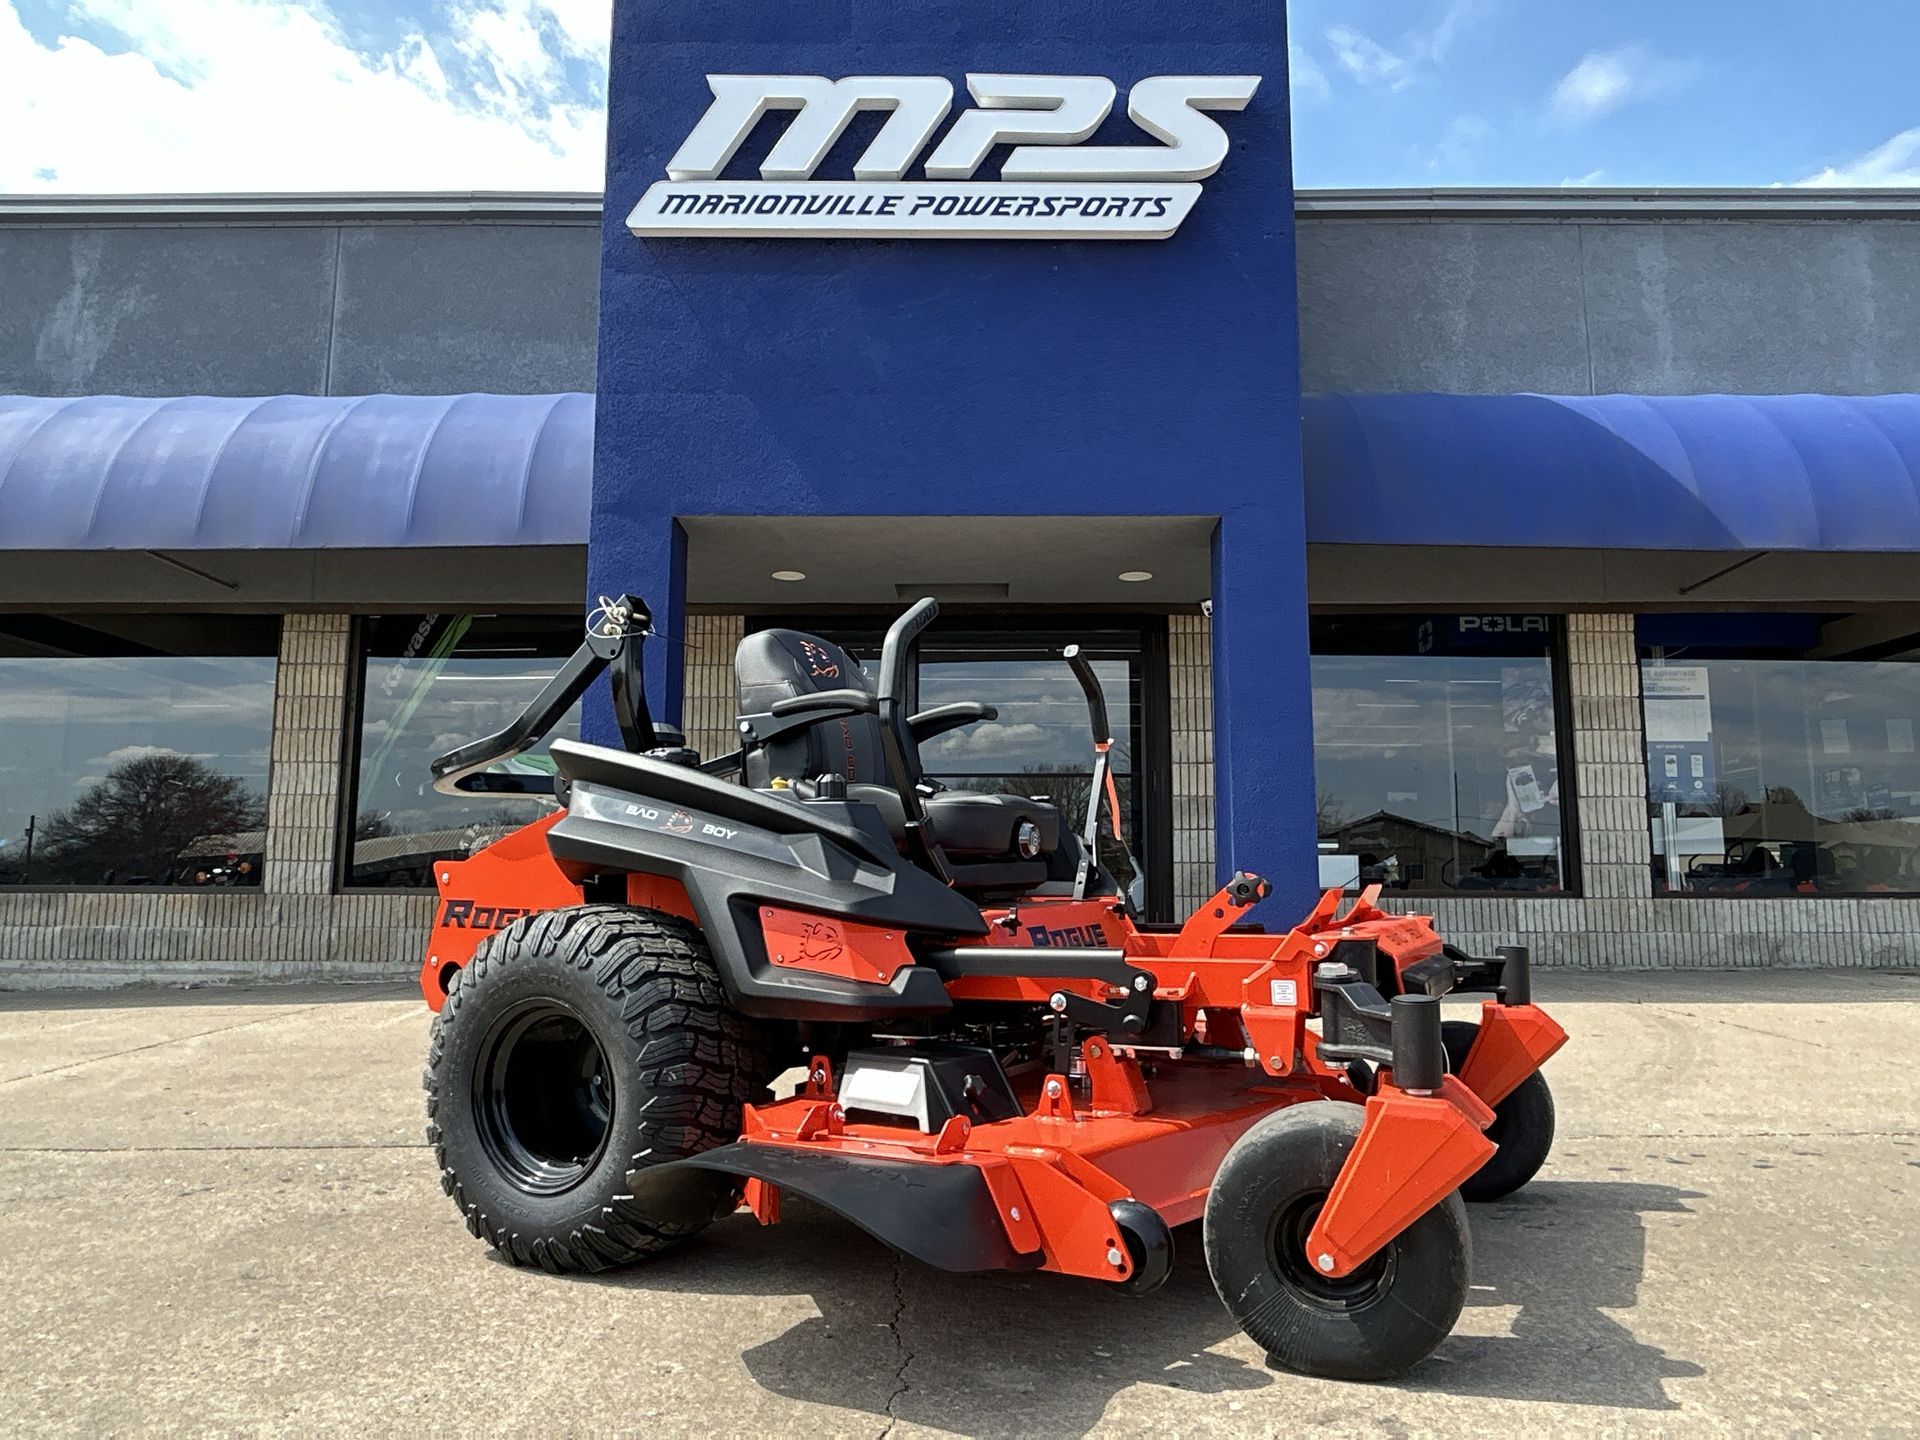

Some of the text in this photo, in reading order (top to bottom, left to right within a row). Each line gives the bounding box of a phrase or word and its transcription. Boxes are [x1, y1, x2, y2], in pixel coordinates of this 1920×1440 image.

[665, 74, 1263, 181] MPS
[657, 194, 1172, 217] MARIONVILLE POWERSPORTS
[625, 804, 738, 840] BAD BOY
